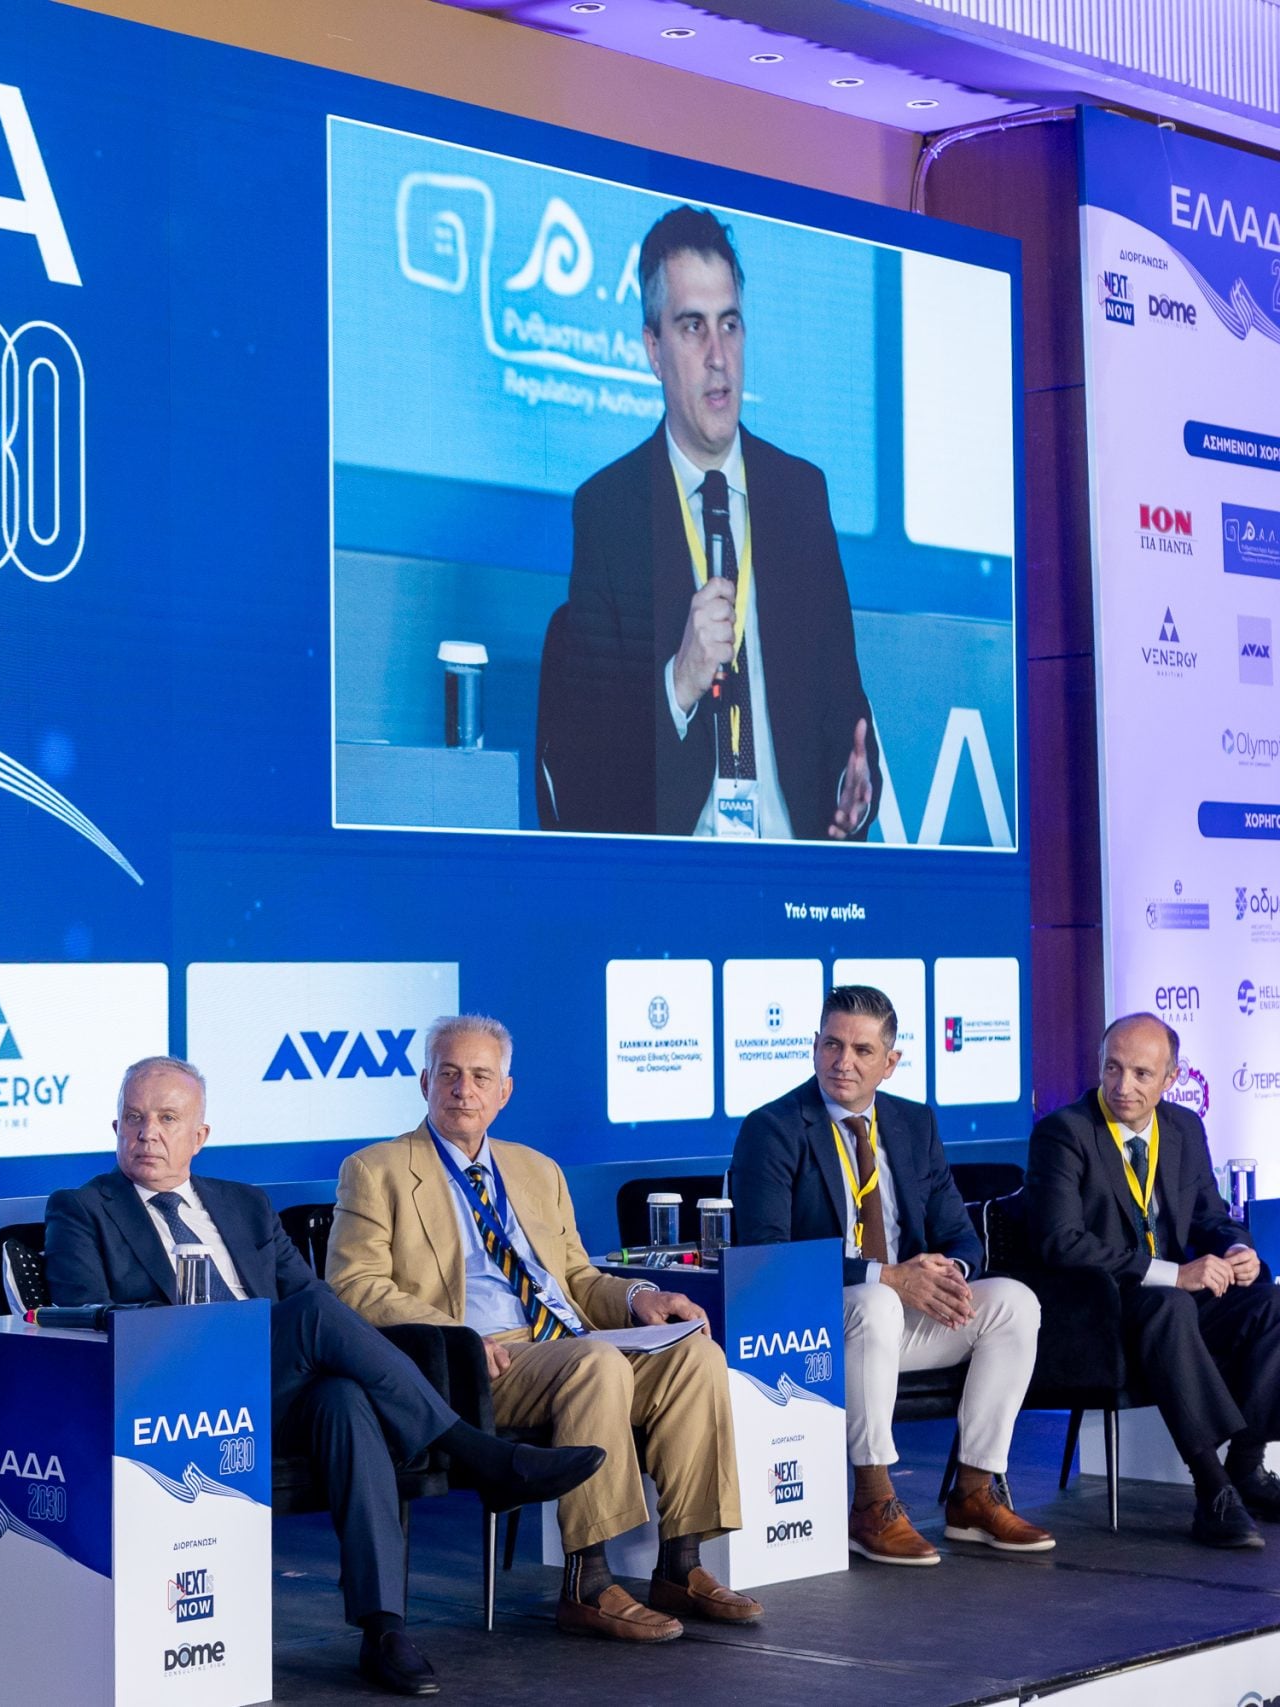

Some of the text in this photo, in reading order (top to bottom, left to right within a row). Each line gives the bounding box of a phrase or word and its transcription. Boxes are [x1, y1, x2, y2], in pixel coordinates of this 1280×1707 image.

[1120, 249, 1169, 270] ΔΙΟΡΓΑΝΩΣΗ
[1104, 270, 1128, 299] NEXT
[1107, 302, 1132, 321] NOW
[1203, 433, 1258, 458] ΑΣΗΜΕΝΙΟΙ
[1159, 538, 1193, 556] ΠΑΝΤΑ
[1141, 647, 1198, 668] VENERGY
[1241, 643, 1270, 658] AVAX
[785, 902, 866, 921] Υπό την αιγίδα
[1250, 887, 1280, 920] αδμ
[1156, 986, 1200, 1010] eren
[262, 1029, 417, 1081] AVAX
[740, 1327, 831, 1359] ΕΛΛΑΔΑ
[805, 1351, 833, 1384] 2030
[134, 1407, 254, 1445] ΕΛΛΑΔΑ
[220, 1437, 255, 1475] 2030
[774, 1460, 798, 1482] NEXT
[28, 1484, 67, 1522] 2030
[777, 1485, 801, 1500] NOW
[173, 1538, 217, 1551] ΔΙΟΡΓΑΝΩΣΗ
[176, 1568, 207, 1595] NEXT
[179, 1599, 211, 1618] NOW
